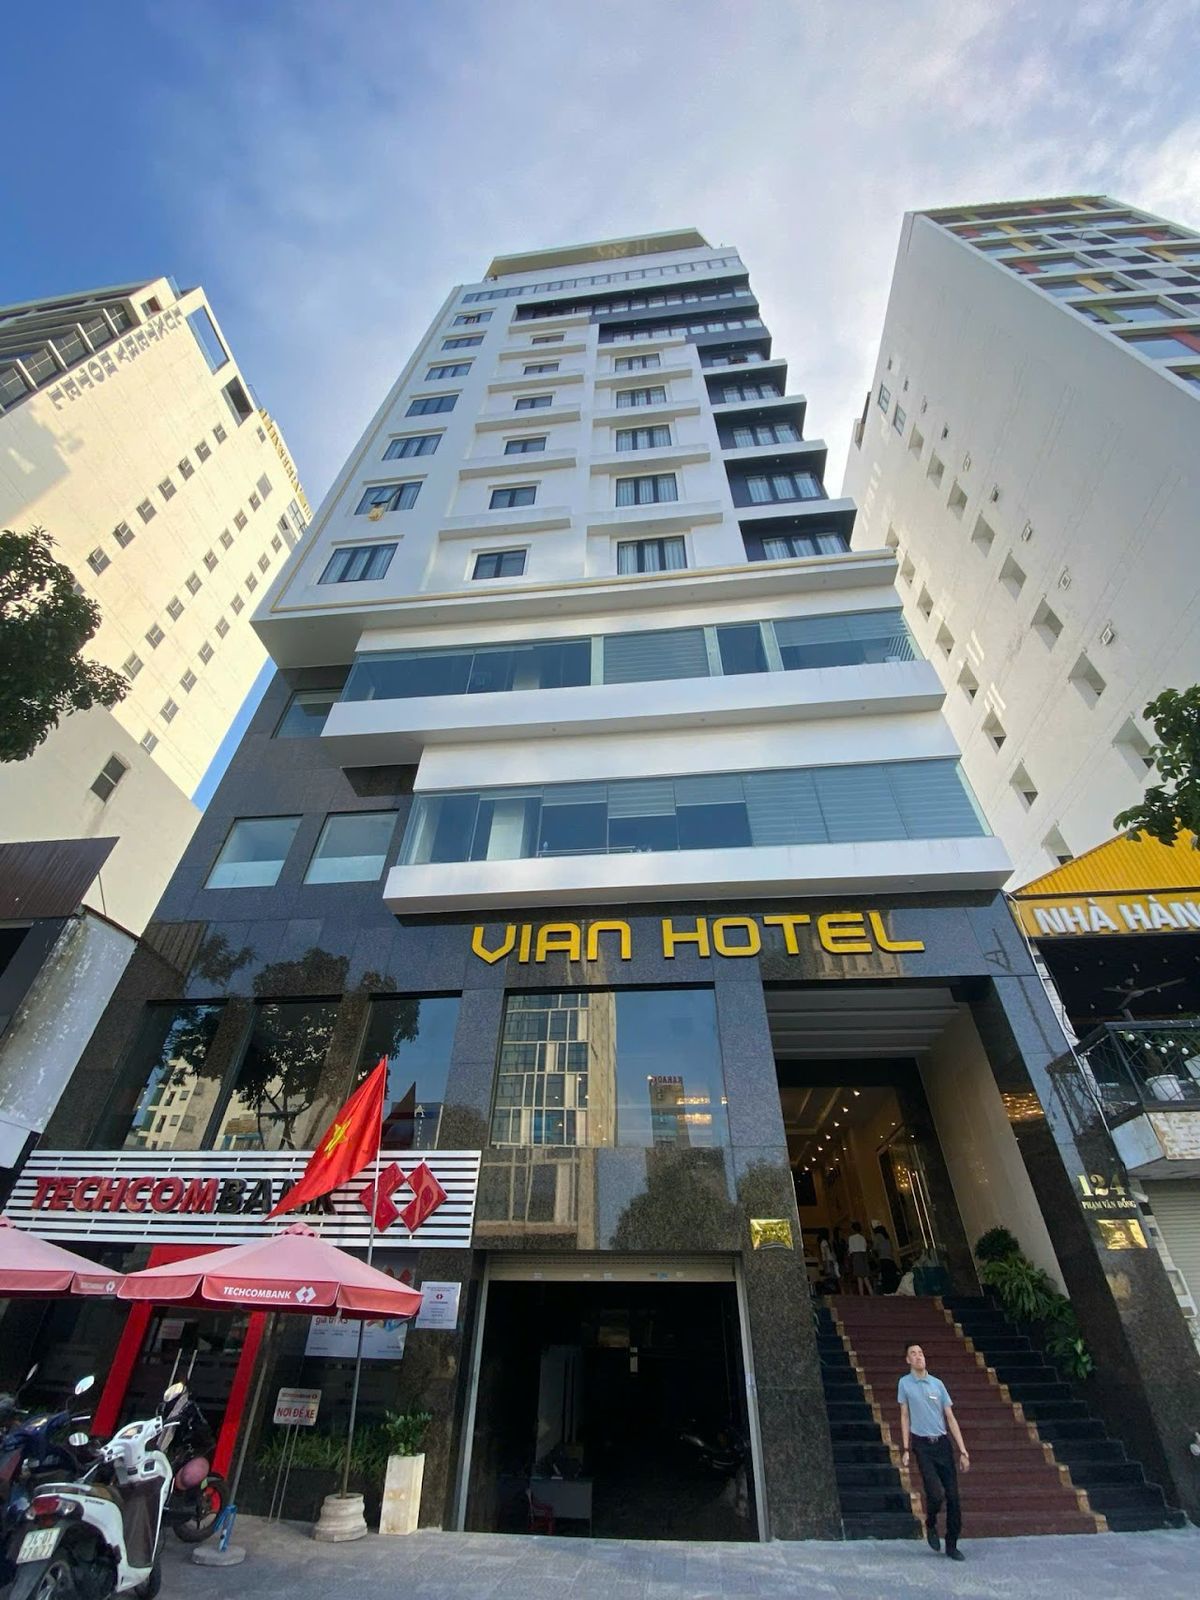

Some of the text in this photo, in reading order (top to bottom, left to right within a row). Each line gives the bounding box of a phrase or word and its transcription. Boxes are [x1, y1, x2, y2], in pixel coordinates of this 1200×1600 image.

[1033, 895, 1200, 934] NHÀ HÀN
[471, 910, 925, 964] VIAN HOTEL
[1077, 1174, 1127, 1196] 124
[223, 1286, 291, 1300] TECHCOMBANK
